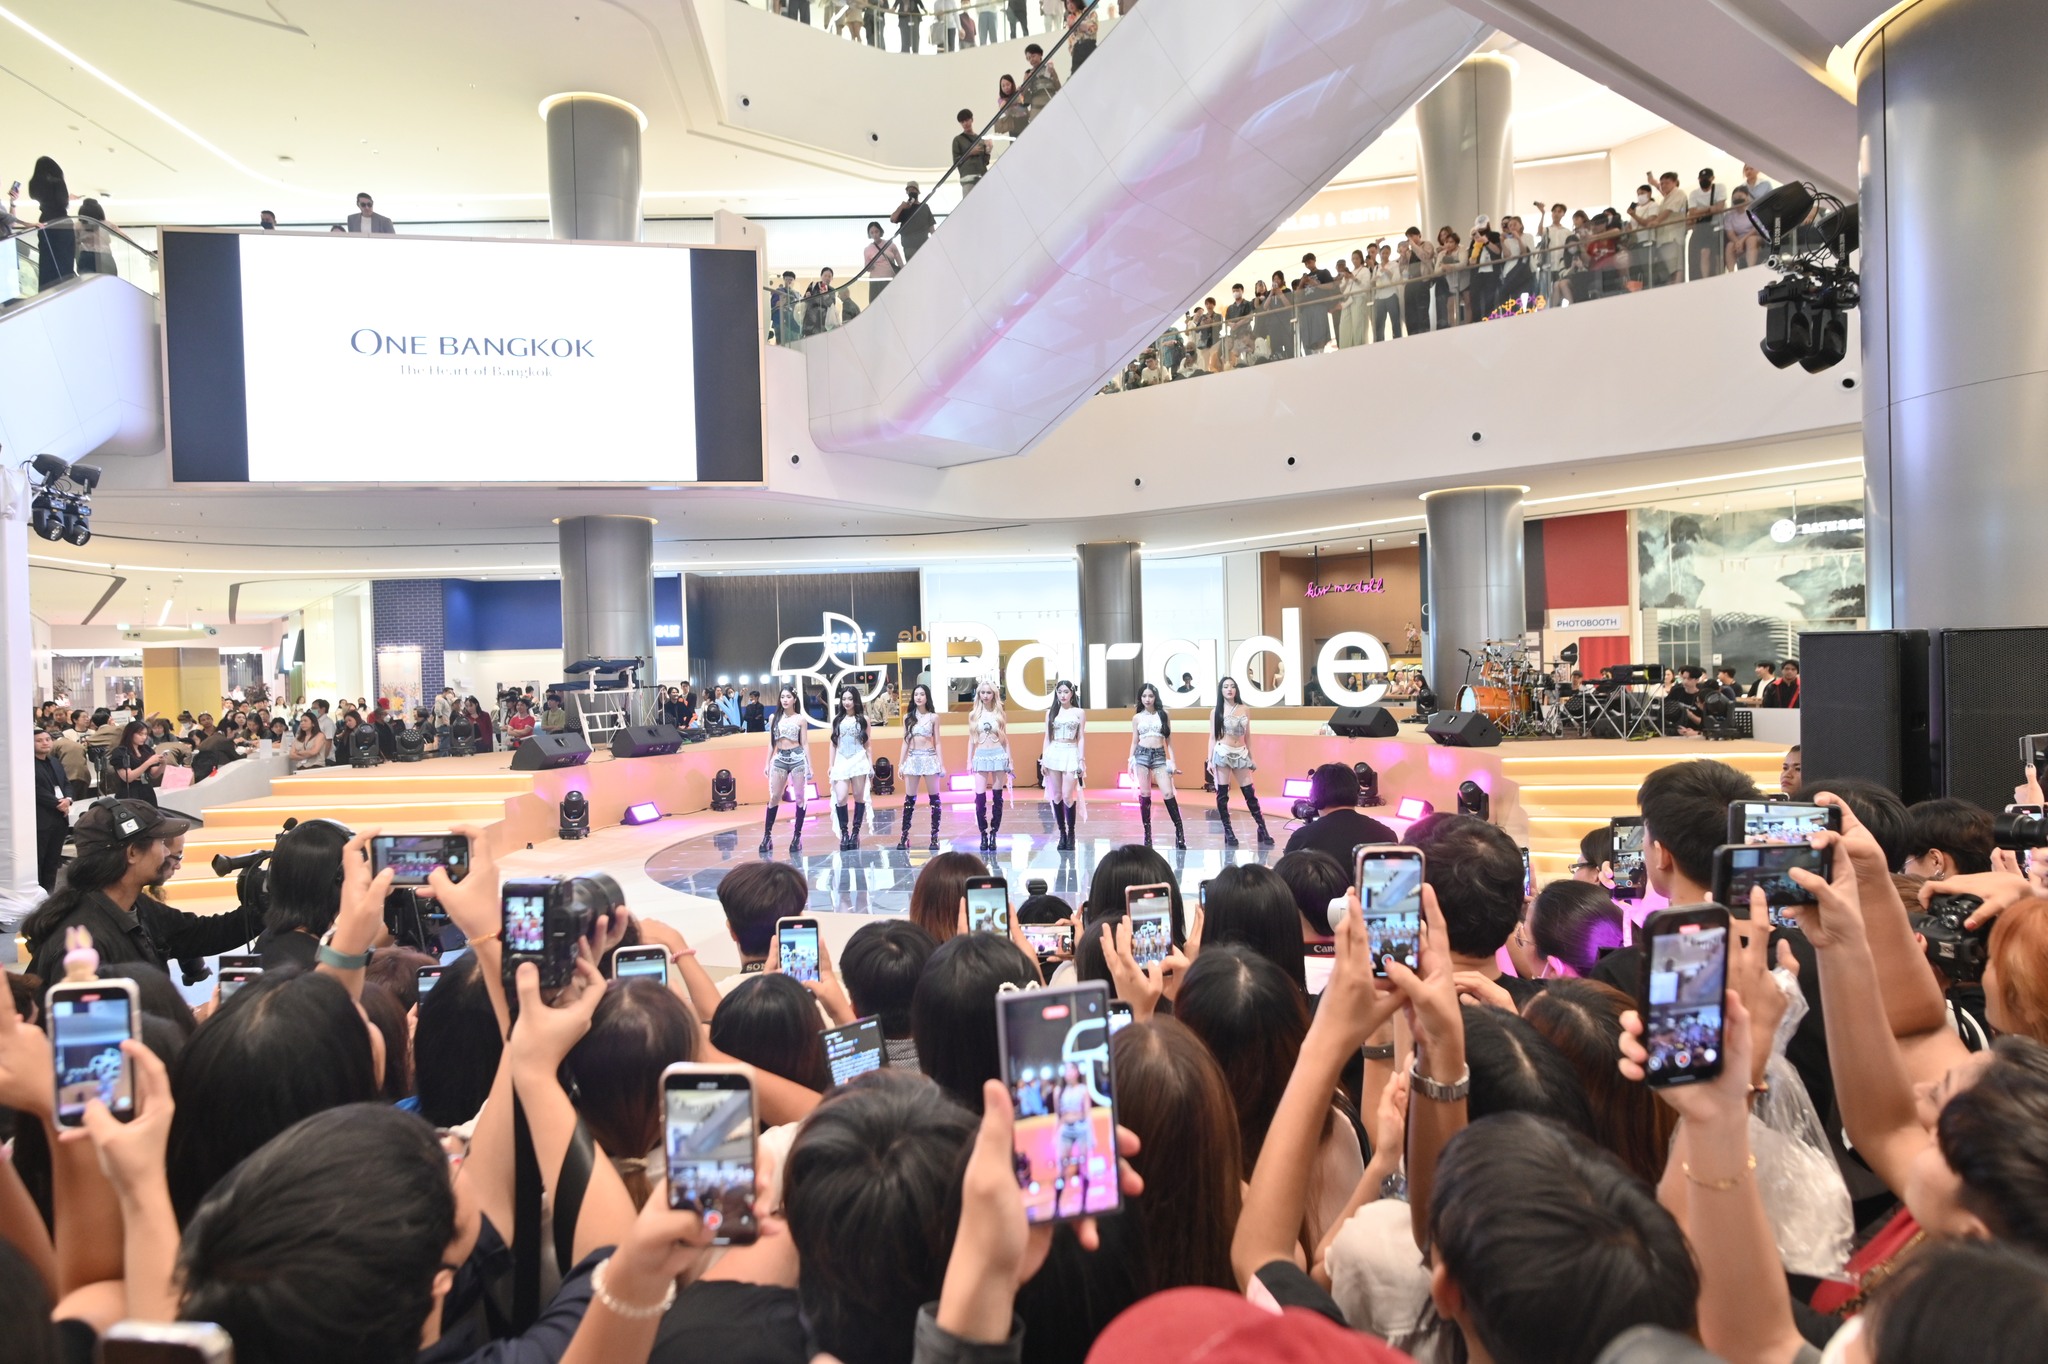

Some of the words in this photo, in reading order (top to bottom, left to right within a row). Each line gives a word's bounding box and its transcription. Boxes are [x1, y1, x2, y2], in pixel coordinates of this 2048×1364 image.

[350, 328, 427, 356] ONE
[439, 336, 595, 358] BANGKOK
[401, 364, 425, 375] The
[429, 365, 468, 376] Heart
[473, 365, 488, 376] of
[492, 366, 553, 379] Bangkok
[1556, 618, 1617, 628] PHOTOBOOTH
[929, 607, 1391, 713] Parade
